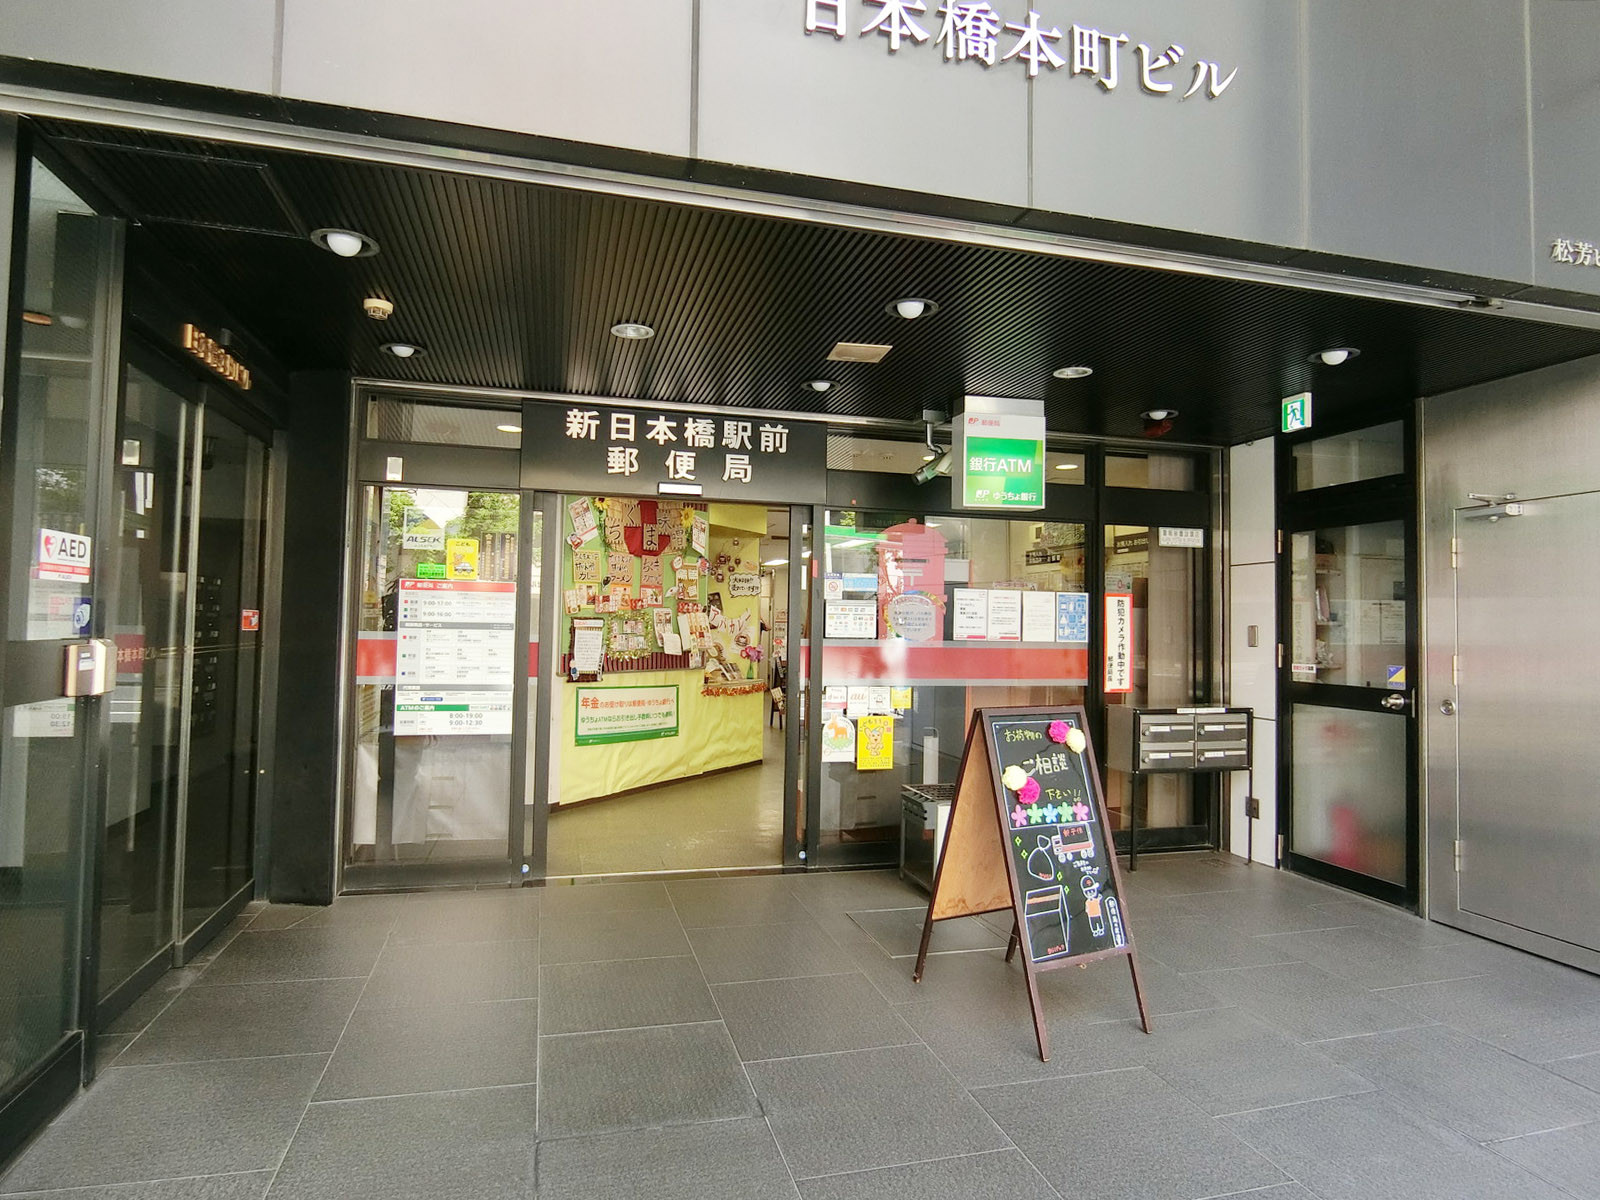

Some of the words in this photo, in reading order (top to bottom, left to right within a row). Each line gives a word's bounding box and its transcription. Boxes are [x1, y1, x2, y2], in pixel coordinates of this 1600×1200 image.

[565, 408, 790, 454] 新日本橋駅前
[606, 446, 753, 484] 郵便局
[968, 456, 1033, 474] 銀行ATM
[993, 491, 1037, 502] ゆうちょ銀行
[57, 537, 87, 559] AED
[1116, 599, 1126, 686] 防犯カメラ作動中です
[1004, 728, 1043, 742] お荷物の
[1022, 752, 1069, 778] ご相談
